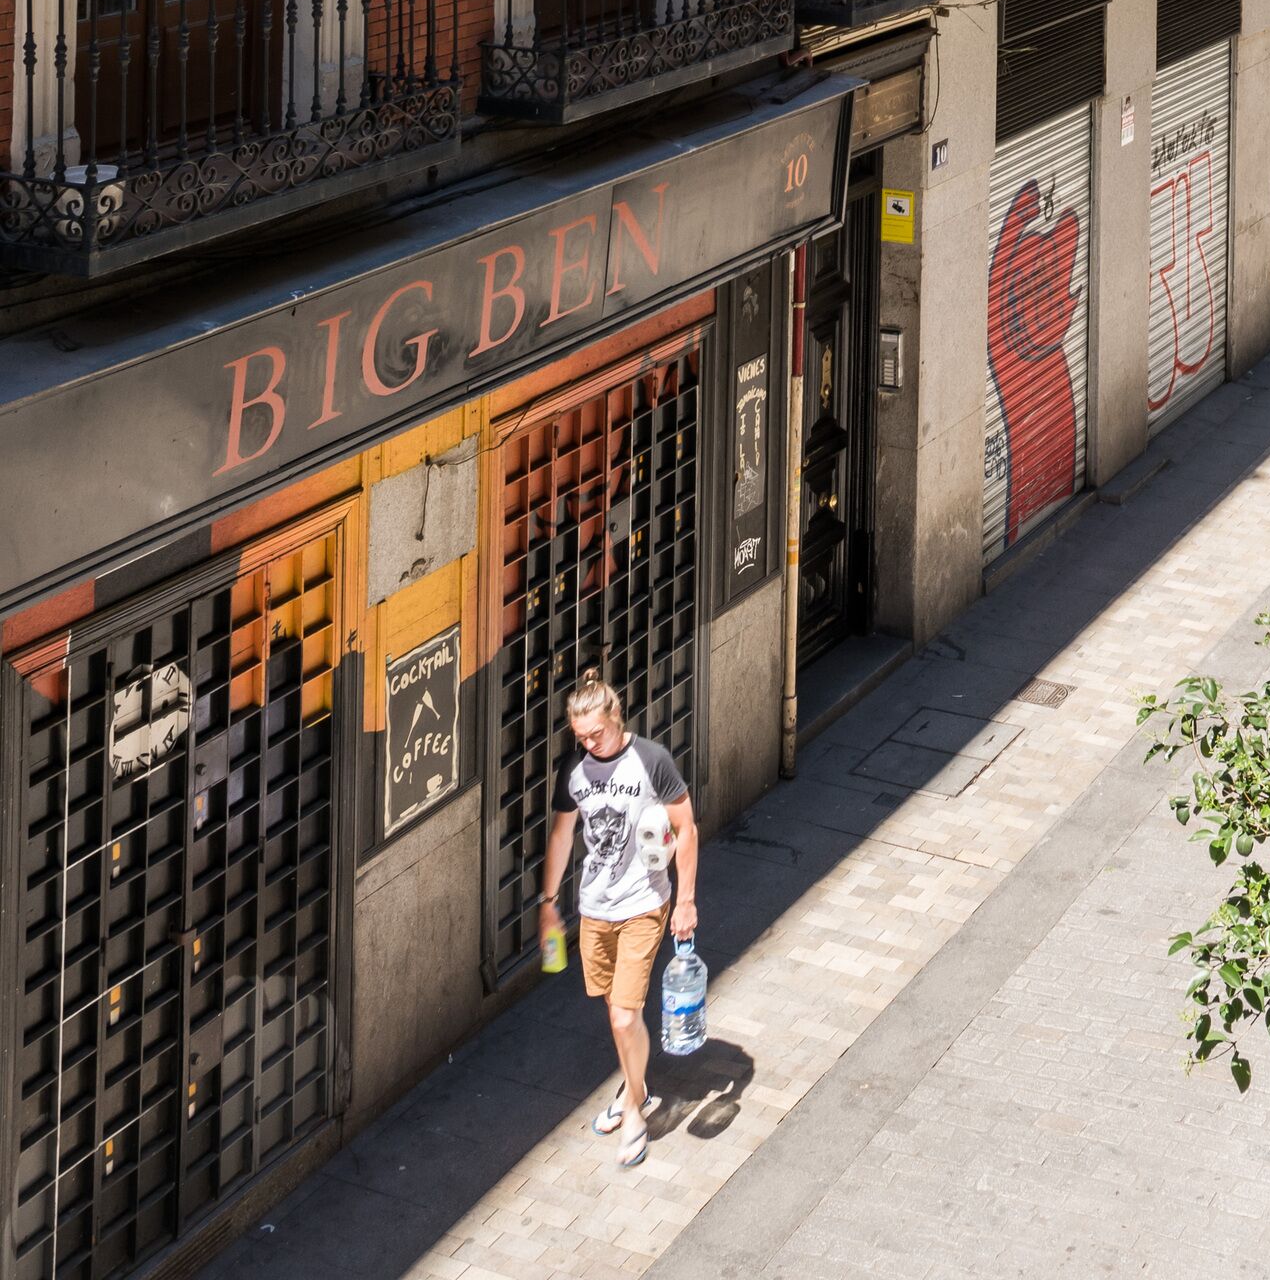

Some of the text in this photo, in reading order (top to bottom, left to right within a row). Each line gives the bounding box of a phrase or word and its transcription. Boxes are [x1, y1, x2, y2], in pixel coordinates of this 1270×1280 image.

[784, 154, 808, 193] 10
[935, 144, 948, 166] 10
[212, 181, 671, 477] BIG BEN
[390, 642, 454, 695] COCKTAIL
[393, 732, 451, 783] COFFEE
